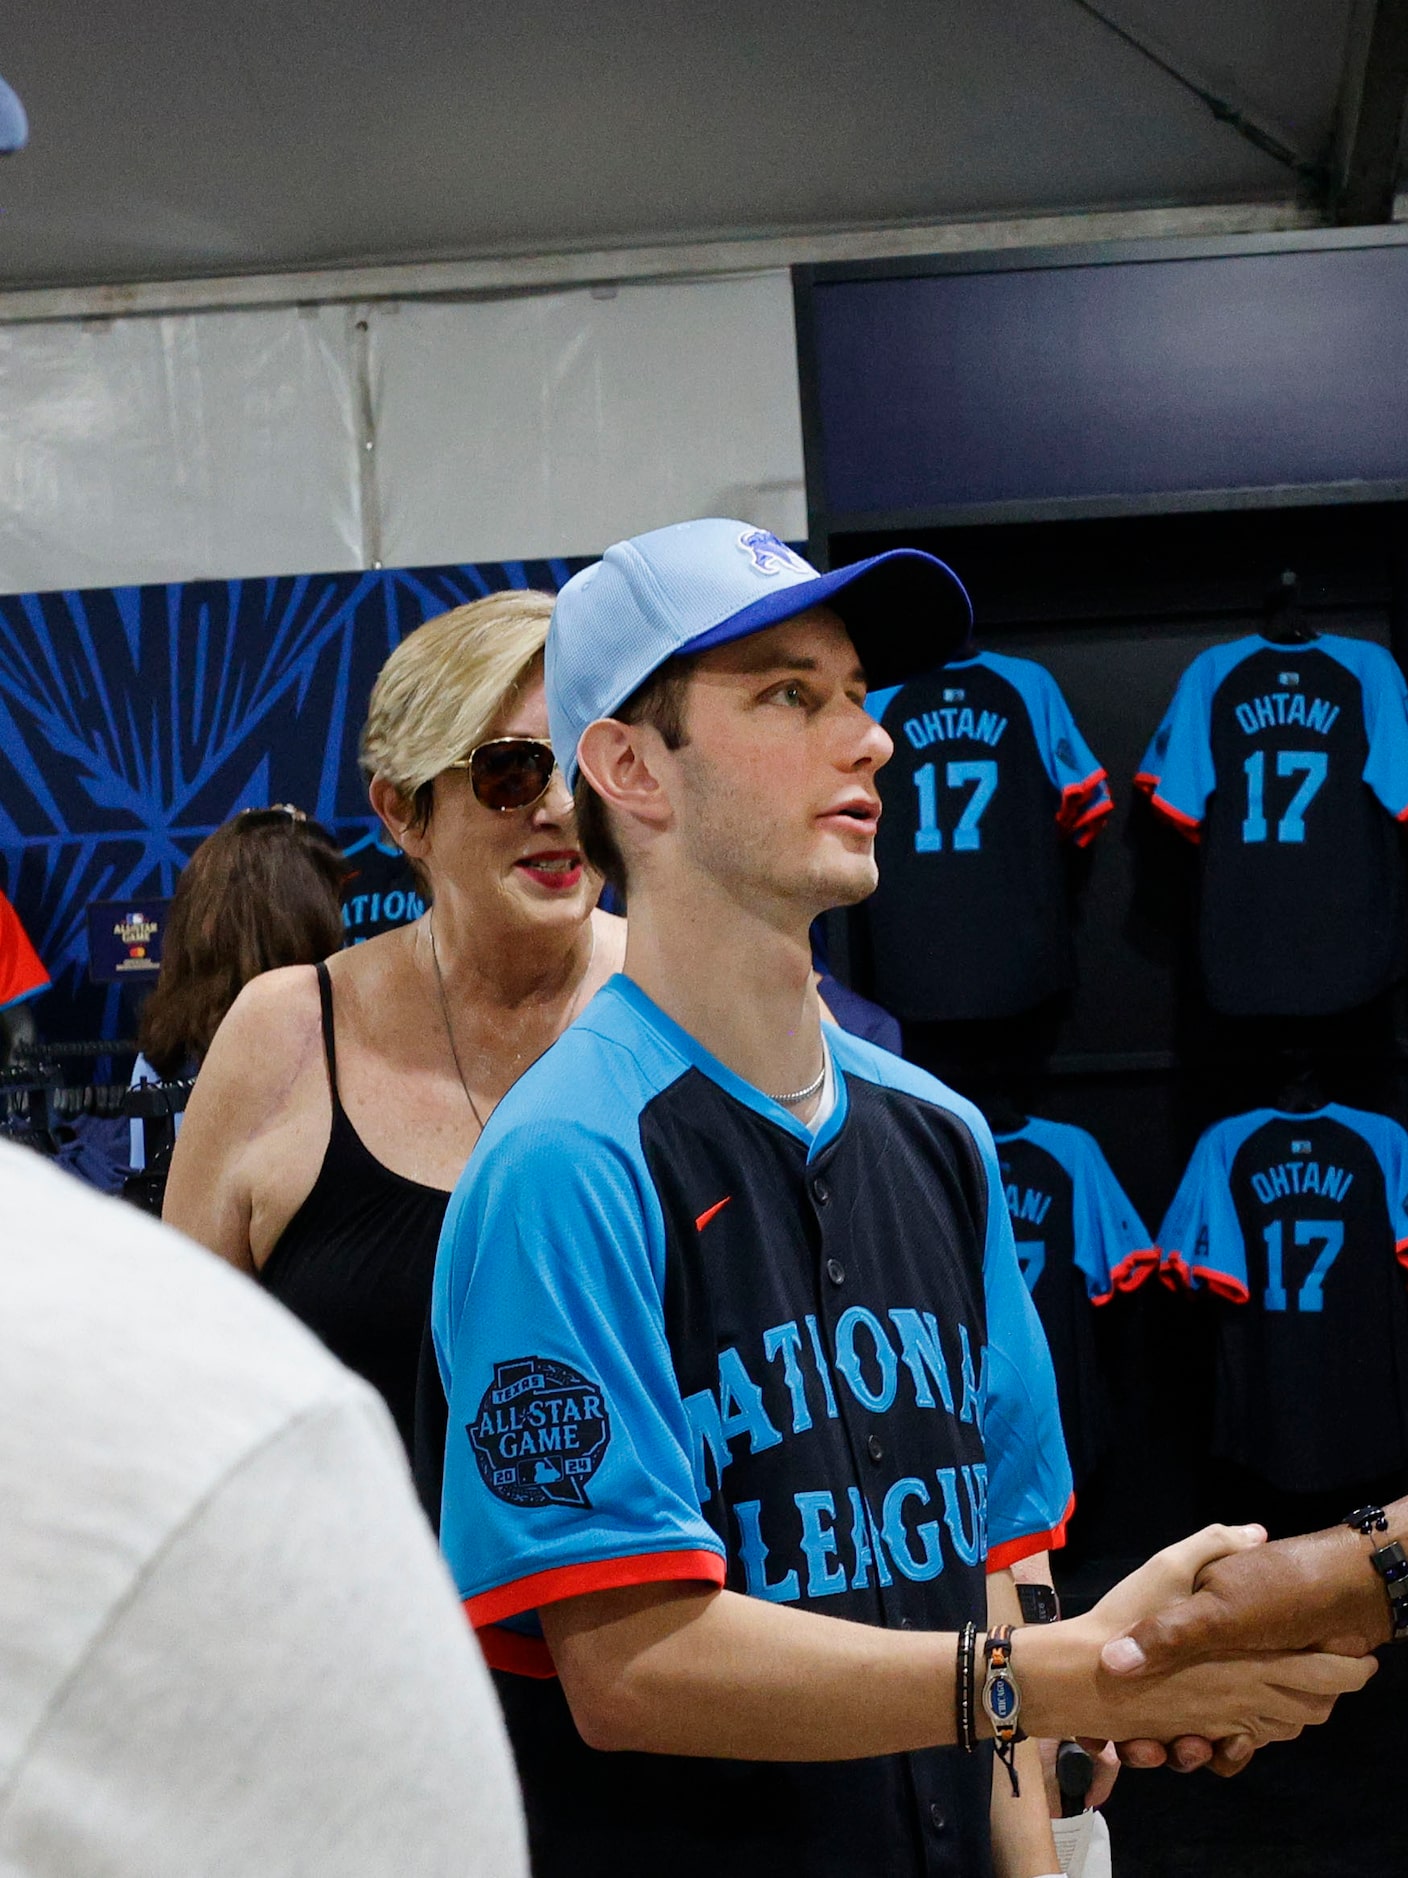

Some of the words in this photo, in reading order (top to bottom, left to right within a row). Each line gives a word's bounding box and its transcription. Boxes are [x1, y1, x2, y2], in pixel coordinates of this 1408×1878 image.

[904, 707, 1008, 750] OHTANI
[1235, 693, 1341, 737] OHTANI
[912, 760, 998, 853] 17
[1242, 750, 1330, 844] 17
[341, 890, 425, 929] ATION
[1005, 1184, 1053, 1226] ANI
[1251, 1162, 1354, 1205] OHTANI
[1013, 1240, 1045, 1294] 7
[1263, 1220, 1345, 1312] 17
[496, 1377, 541, 1404] TEXAS
[682, 1306, 988, 1502] NATIONA
[500, 1425, 579, 1458] GAME
[494, 1468, 515, 1485] 20
[566, 1459, 591, 1475] 24
[996, 1680, 1008, 1716] CHICAGO
